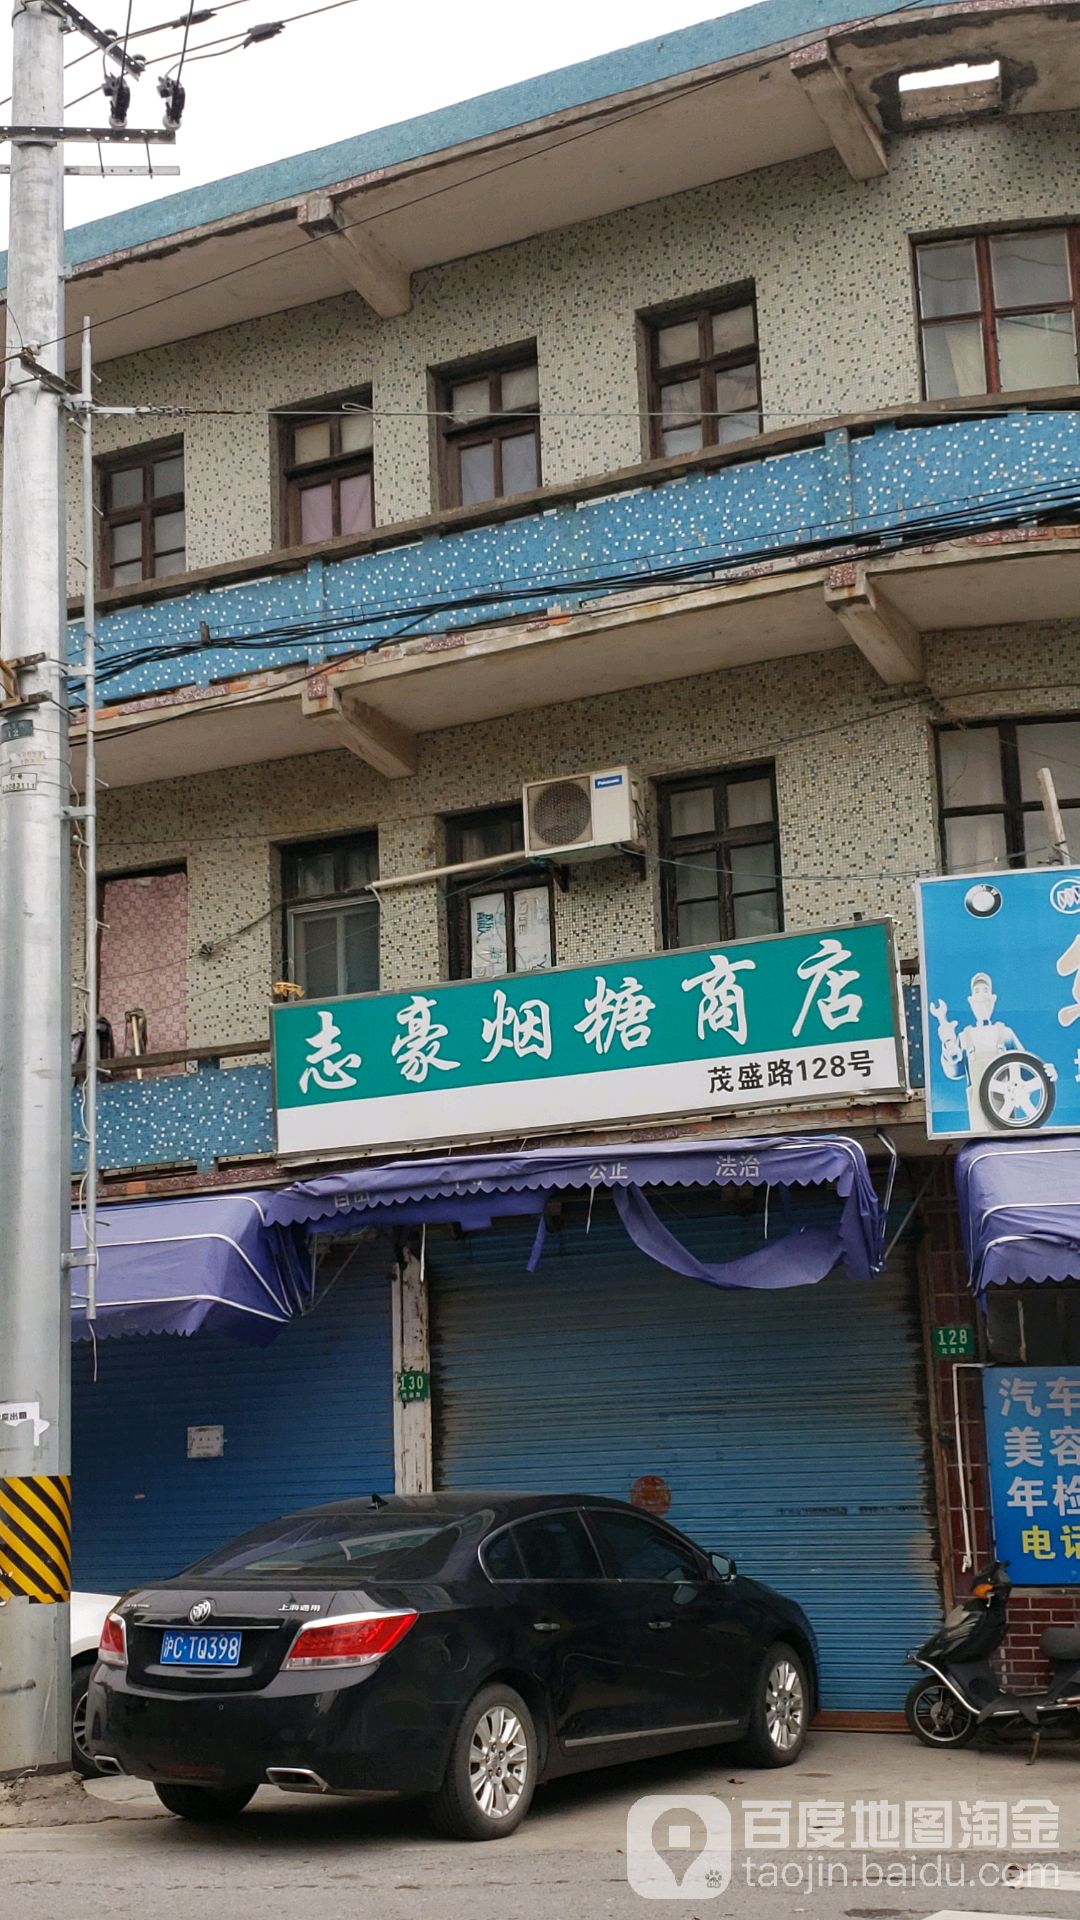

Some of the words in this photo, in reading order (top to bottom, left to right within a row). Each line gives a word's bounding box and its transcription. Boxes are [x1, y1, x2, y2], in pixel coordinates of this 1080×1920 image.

[298, 938, 862, 1094] 志豪烟糖商店
[707, 1050, 874, 1093] 茂盛路128号
[715, 1154, 760, 1177] 法治
[938, 1329, 967, 1345] 128
[400, 1375, 424, 1390] 130
[998, 1376, 1080, 1417] 汽车
[1003, 1425, 1080, 1467] 美容
